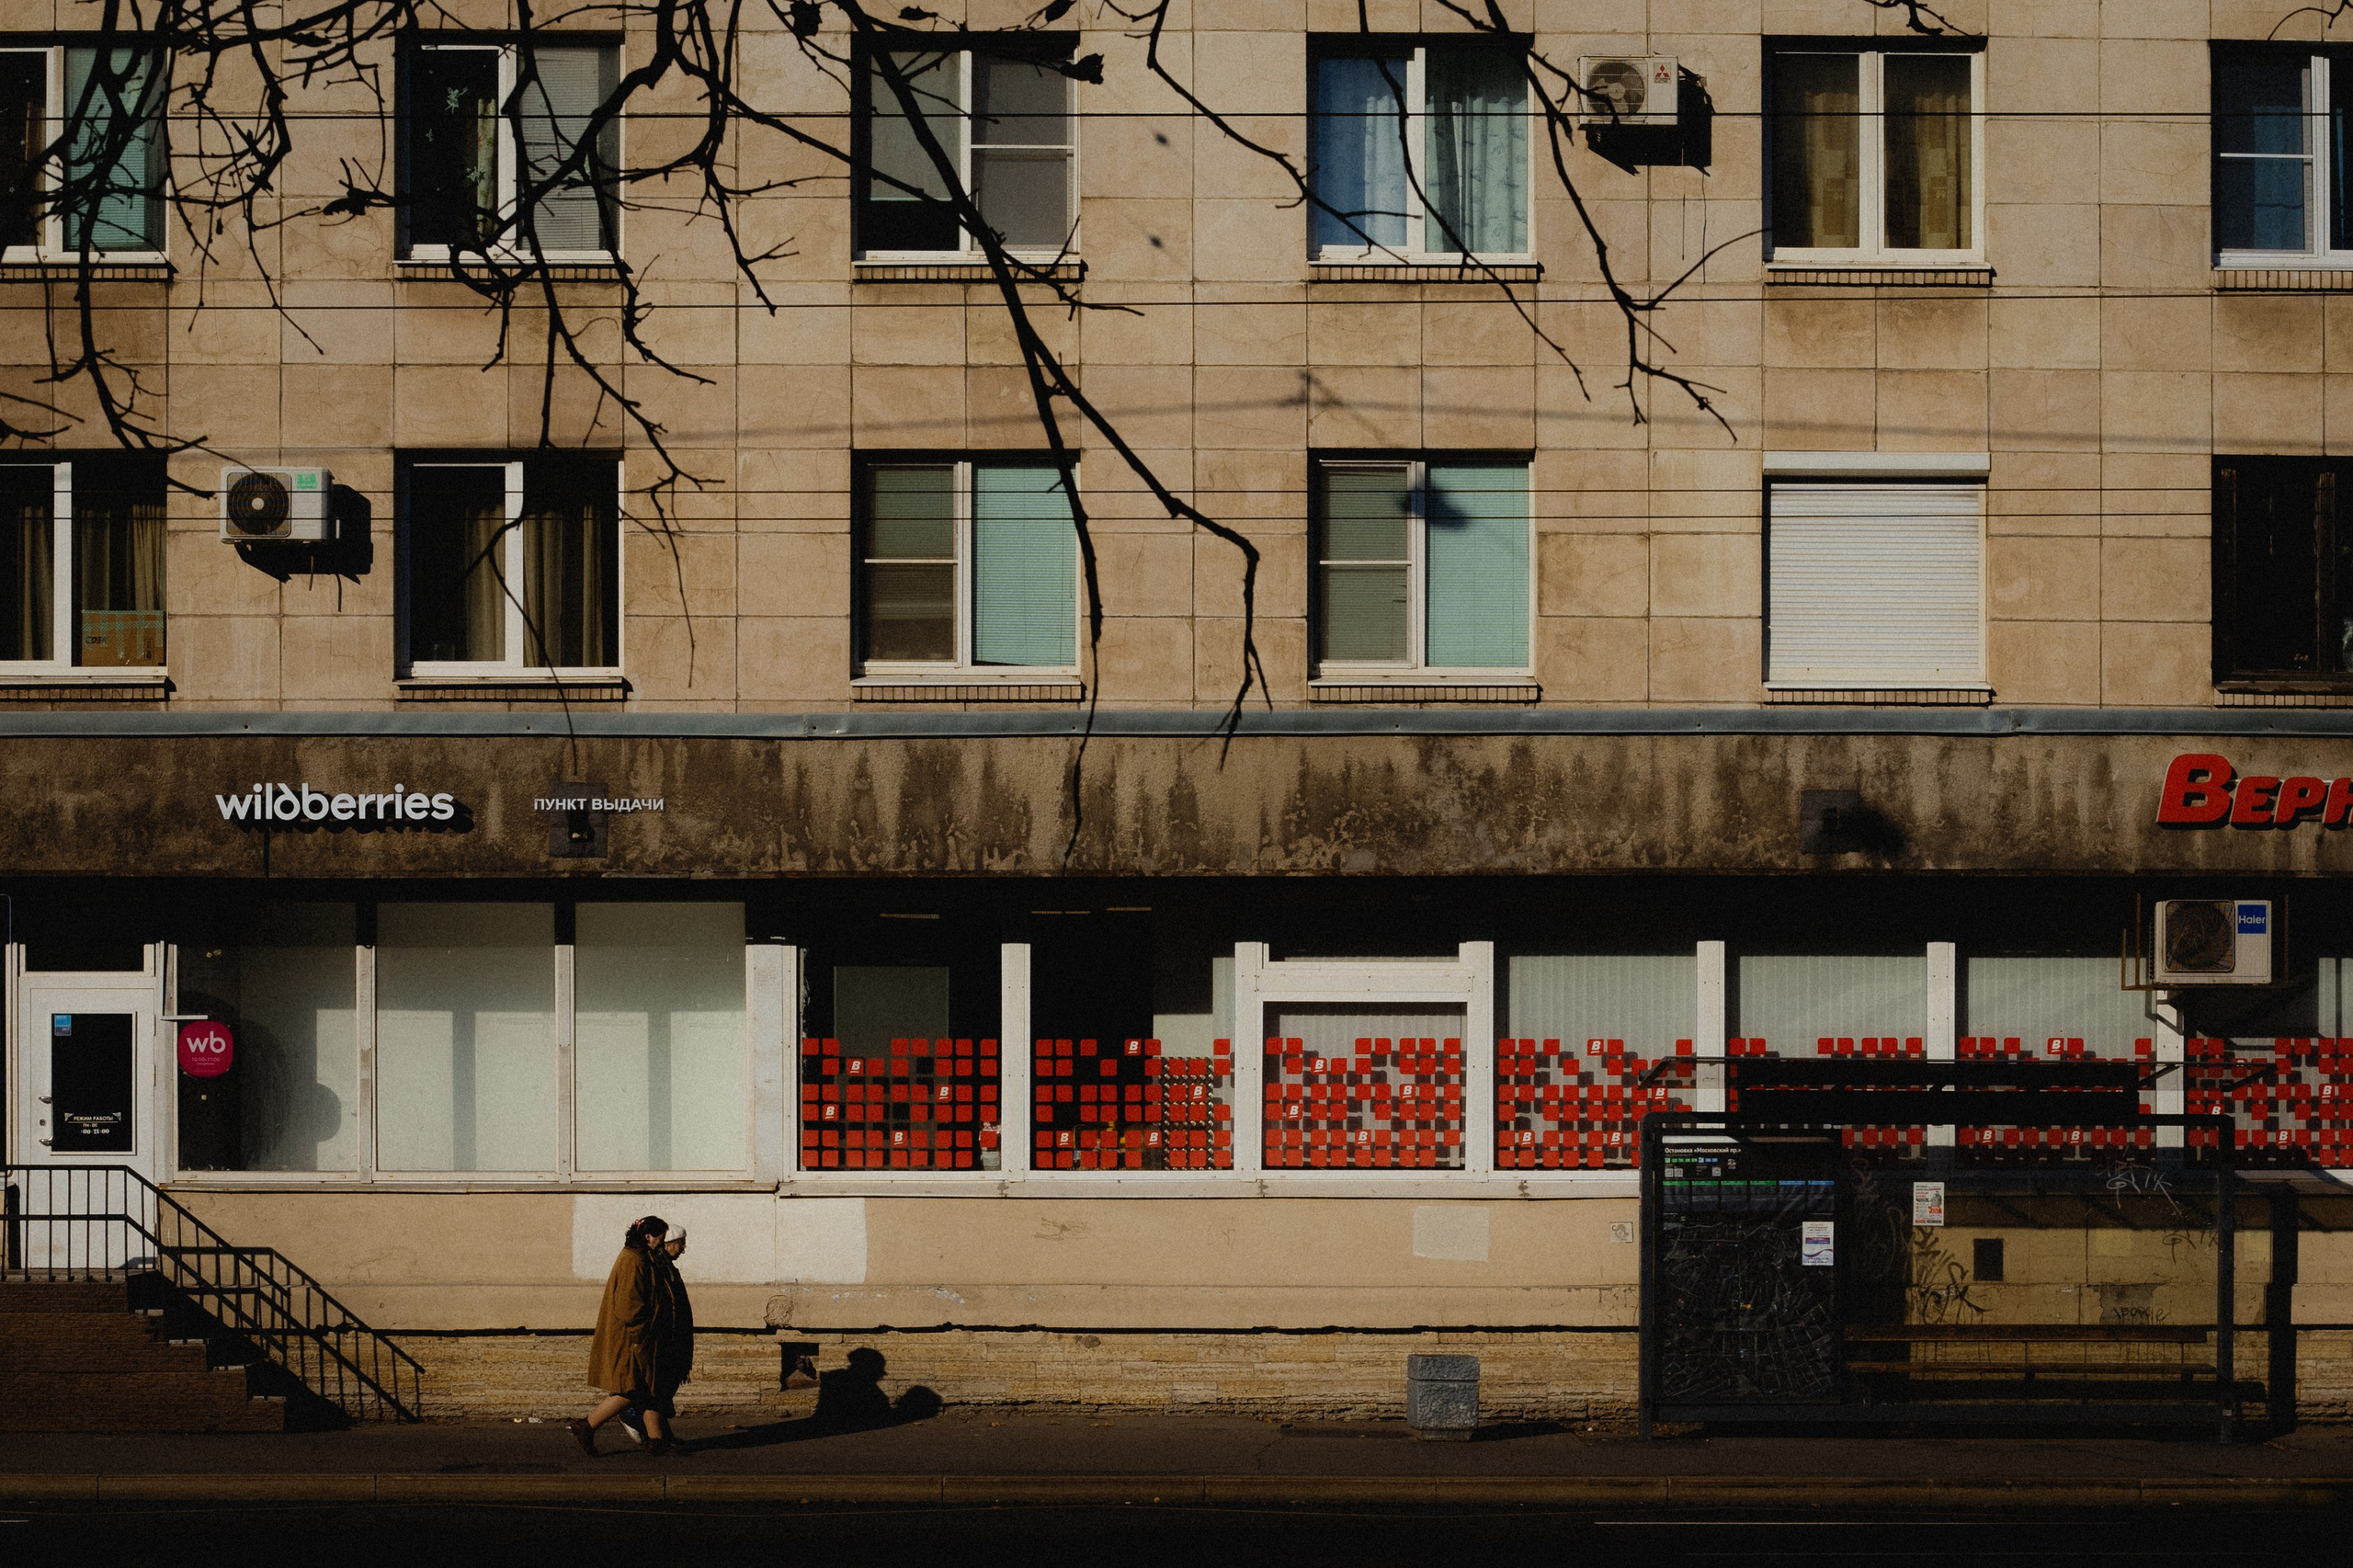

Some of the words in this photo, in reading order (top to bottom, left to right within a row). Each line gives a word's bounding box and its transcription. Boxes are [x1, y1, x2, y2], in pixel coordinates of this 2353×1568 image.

[215, 782, 454, 821] wildberries
[534, 798, 586, 811] ПУНКТ
[592, 798, 665, 812] ВЫДАЧИ
[2238, 915, 2266, 925] Haier
[187, 1030, 226, 1053] wb
